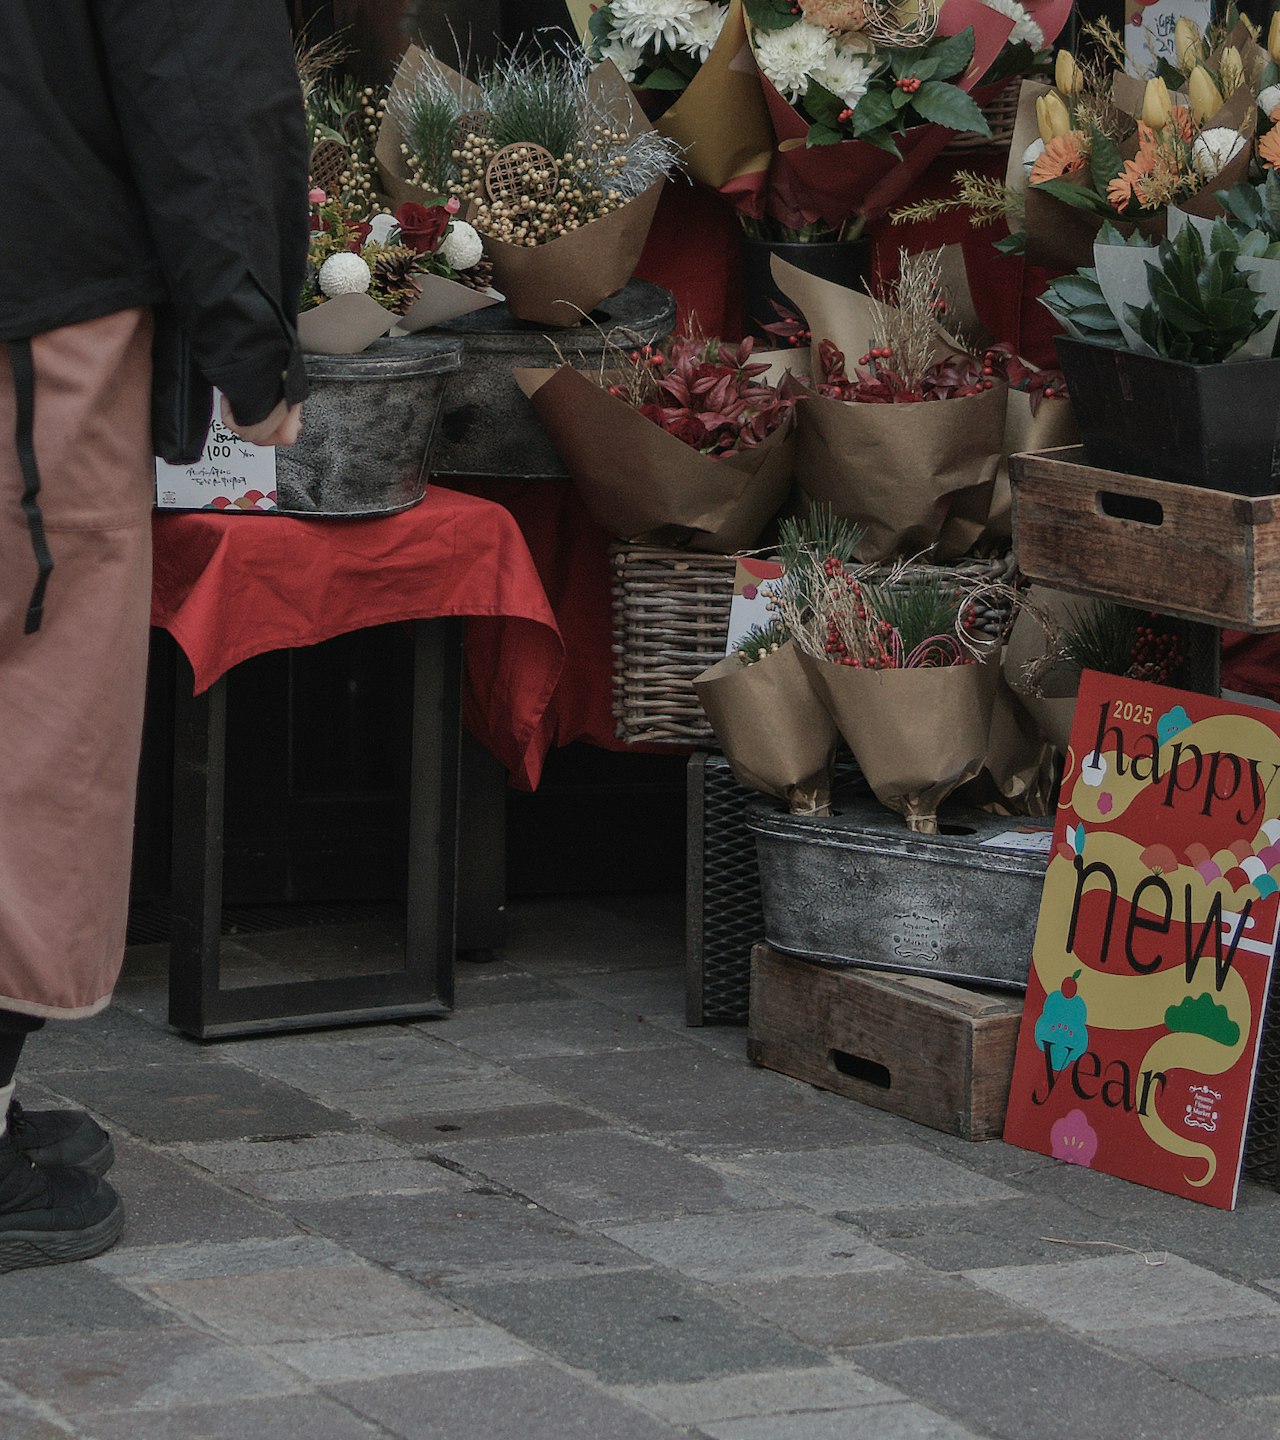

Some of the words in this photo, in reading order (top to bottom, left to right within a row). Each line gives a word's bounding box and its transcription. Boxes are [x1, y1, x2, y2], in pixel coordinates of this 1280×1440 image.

[1113, 699, 1154, 726] 2025
[1065, 854, 1254, 992] new
[1031, 1038, 1167, 1118] year
